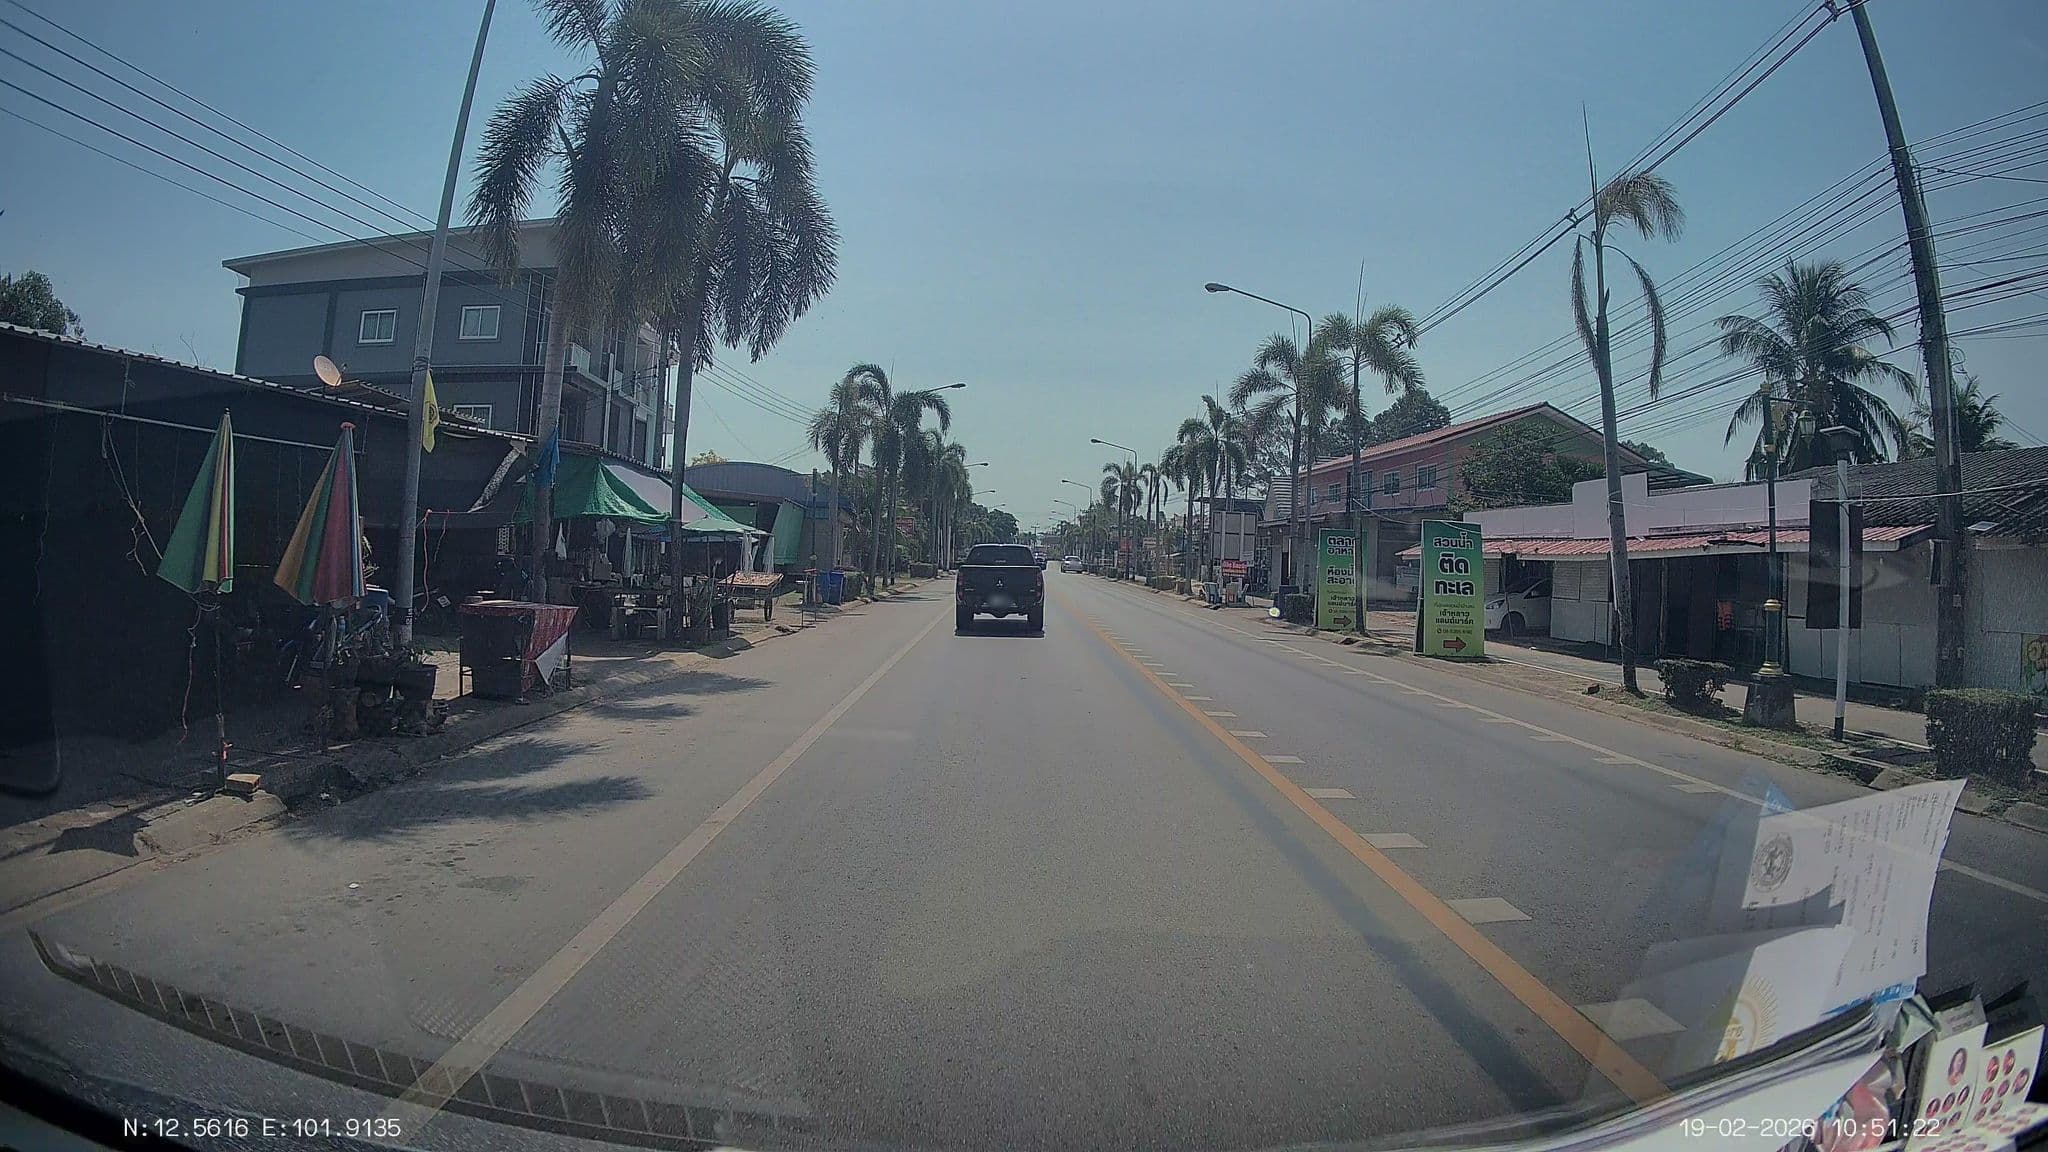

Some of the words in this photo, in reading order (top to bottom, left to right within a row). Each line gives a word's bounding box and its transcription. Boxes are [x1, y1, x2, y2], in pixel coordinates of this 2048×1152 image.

[1433, 532, 1474, 549] สวนน้ำ
[1438, 552, 1470, 575] ติด
[1327, 576, 1354, 585] สะอา
[1434, 580, 1475, 596] ทะเล
